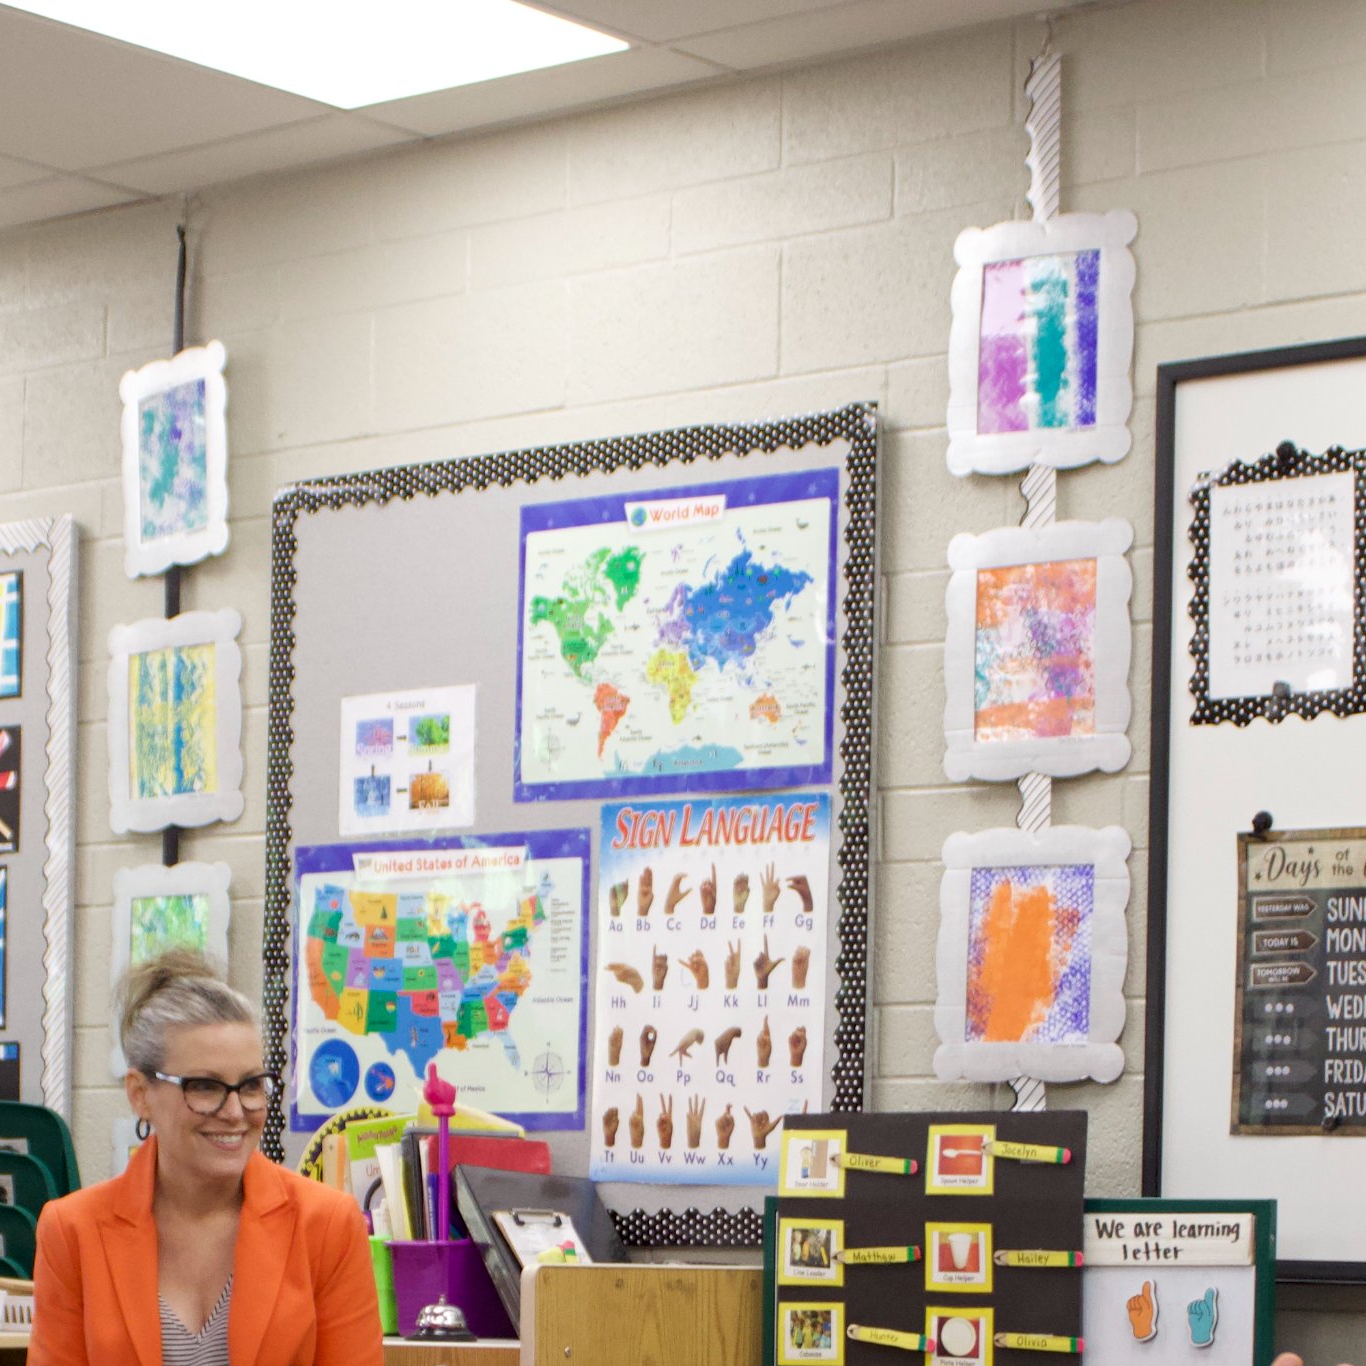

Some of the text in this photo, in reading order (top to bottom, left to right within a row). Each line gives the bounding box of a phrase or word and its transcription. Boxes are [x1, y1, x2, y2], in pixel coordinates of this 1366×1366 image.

[649, 503, 720, 523] World Map
[611, 801, 820, 850] SIGN LANGUAGE
[1335, 847, 1351, 862] of
[373, 853, 521, 875] United States of America
[1265, 846, 1324, 886] Days
[1332, 861, 1354, 877] the
[609, 919, 623, 932] Aa
[636, 918, 651, 932] Bb
[666, 918, 682, 931] Cc
[700, 917, 716, 930] Dd
[732, 916, 746, 929] Ee
[763, 915, 774, 928] Ff
[795, 914, 814, 932] Gg
[1263, 936, 1290, 947] TODAY
[611, 996, 626, 1009] Hh
[653, 996, 661, 1008] Ii
[688, 995, 699, 1011] Jj
[724, 995, 739, 1008] Kk
[757, 995, 767, 1007] Ll
[787, 994, 810, 1007] Mm
[605, 1070, 621, 1083] Nn
[637, 1070, 654, 1083] Oo
[677, 1070, 691, 1087] Pp
[715, 1070, 736, 1088] Qq
[757, 1070, 770, 1083] Rr
[791, 1070, 804, 1083] Ss
[604, 1150, 614, 1164] Tt
[1001, 1142, 1037, 1159] Jocelyn
[629, 1151, 645, 1164] Uu
[658, 1151, 672, 1164] Vv
[684, 1151, 706, 1165] Ww
[717, 1152, 733, 1165] Xx
[753, 1152, 768, 1170] Yy
[849, 1155, 882, 1169] Oliver
[958, 1176, 980, 1186] Helper
[1095, 1218, 1241, 1244] We are learning
[1122, 1241, 1184, 1262] letter
[1016, 1252, 1050, 1266] Hailey
[806, 1269, 826, 1278] Leader
[943, 1274, 975, 1283] Cup Helper
[869, 1329, 900, 1344] Hunter
[1016, 1335, 1048, 1348] Olivia
